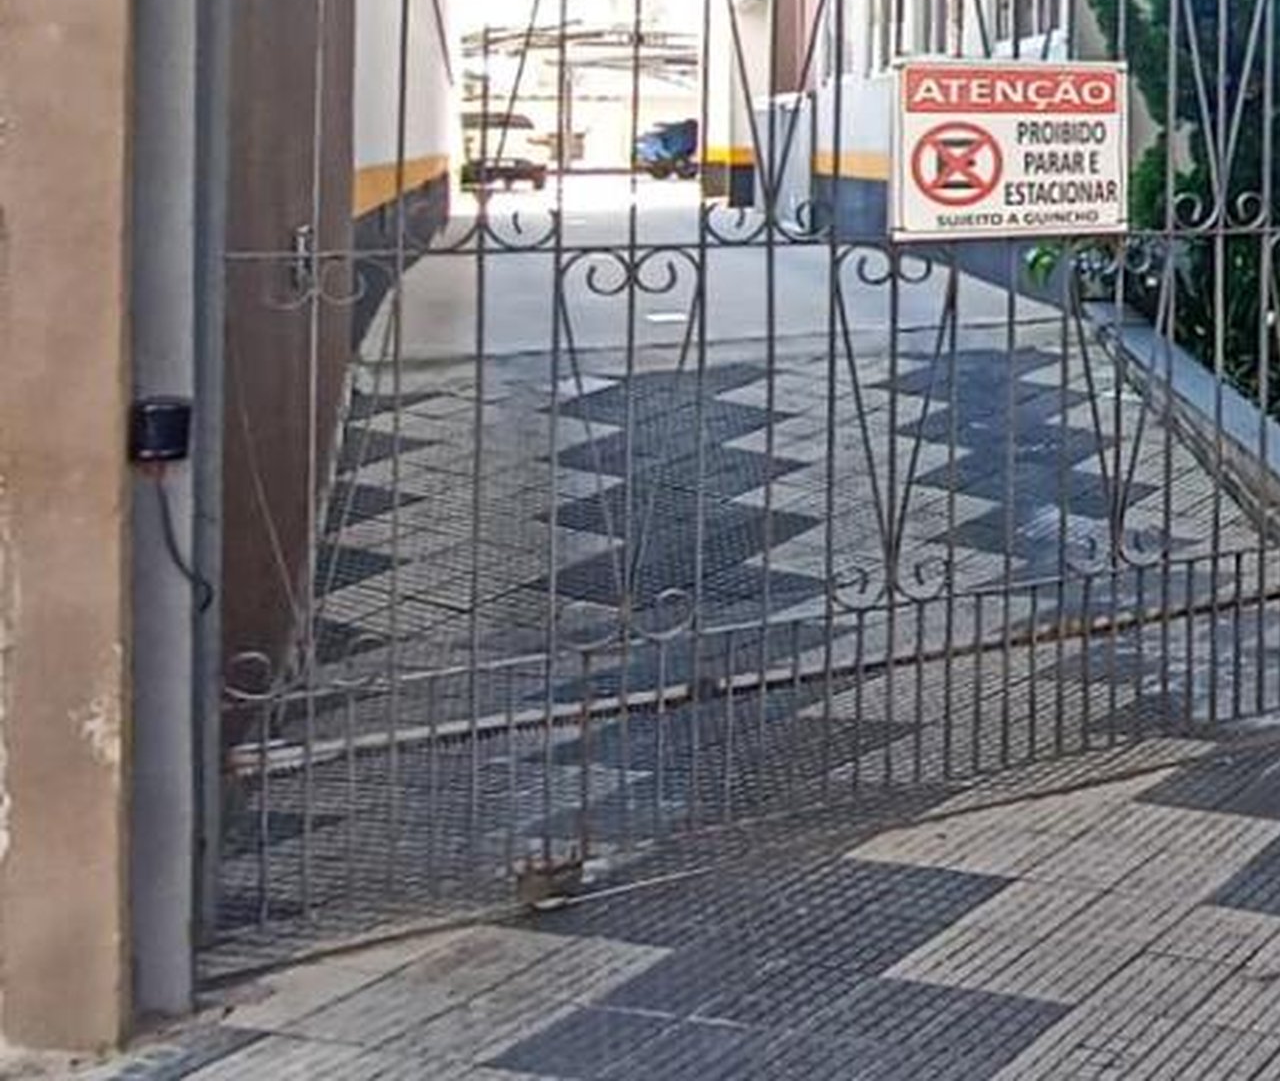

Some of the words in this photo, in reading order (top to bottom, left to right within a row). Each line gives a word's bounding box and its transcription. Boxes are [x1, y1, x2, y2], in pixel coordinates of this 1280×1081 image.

[913, 75, 1112, 109] ATENÇÃO
[1016, 121, 1107, 145] PROIBIDO
[1024, 151, 1084, 175] PARAR
[1089, 150, 1099, 174] E
[1004, 180, 1118, 206] ESTACIONAR
[936, 213, 1003, 227] SUJEITO
[1007, 212, 1020, 226] A
[1023, 210, 1099, 226] GUINCHO
